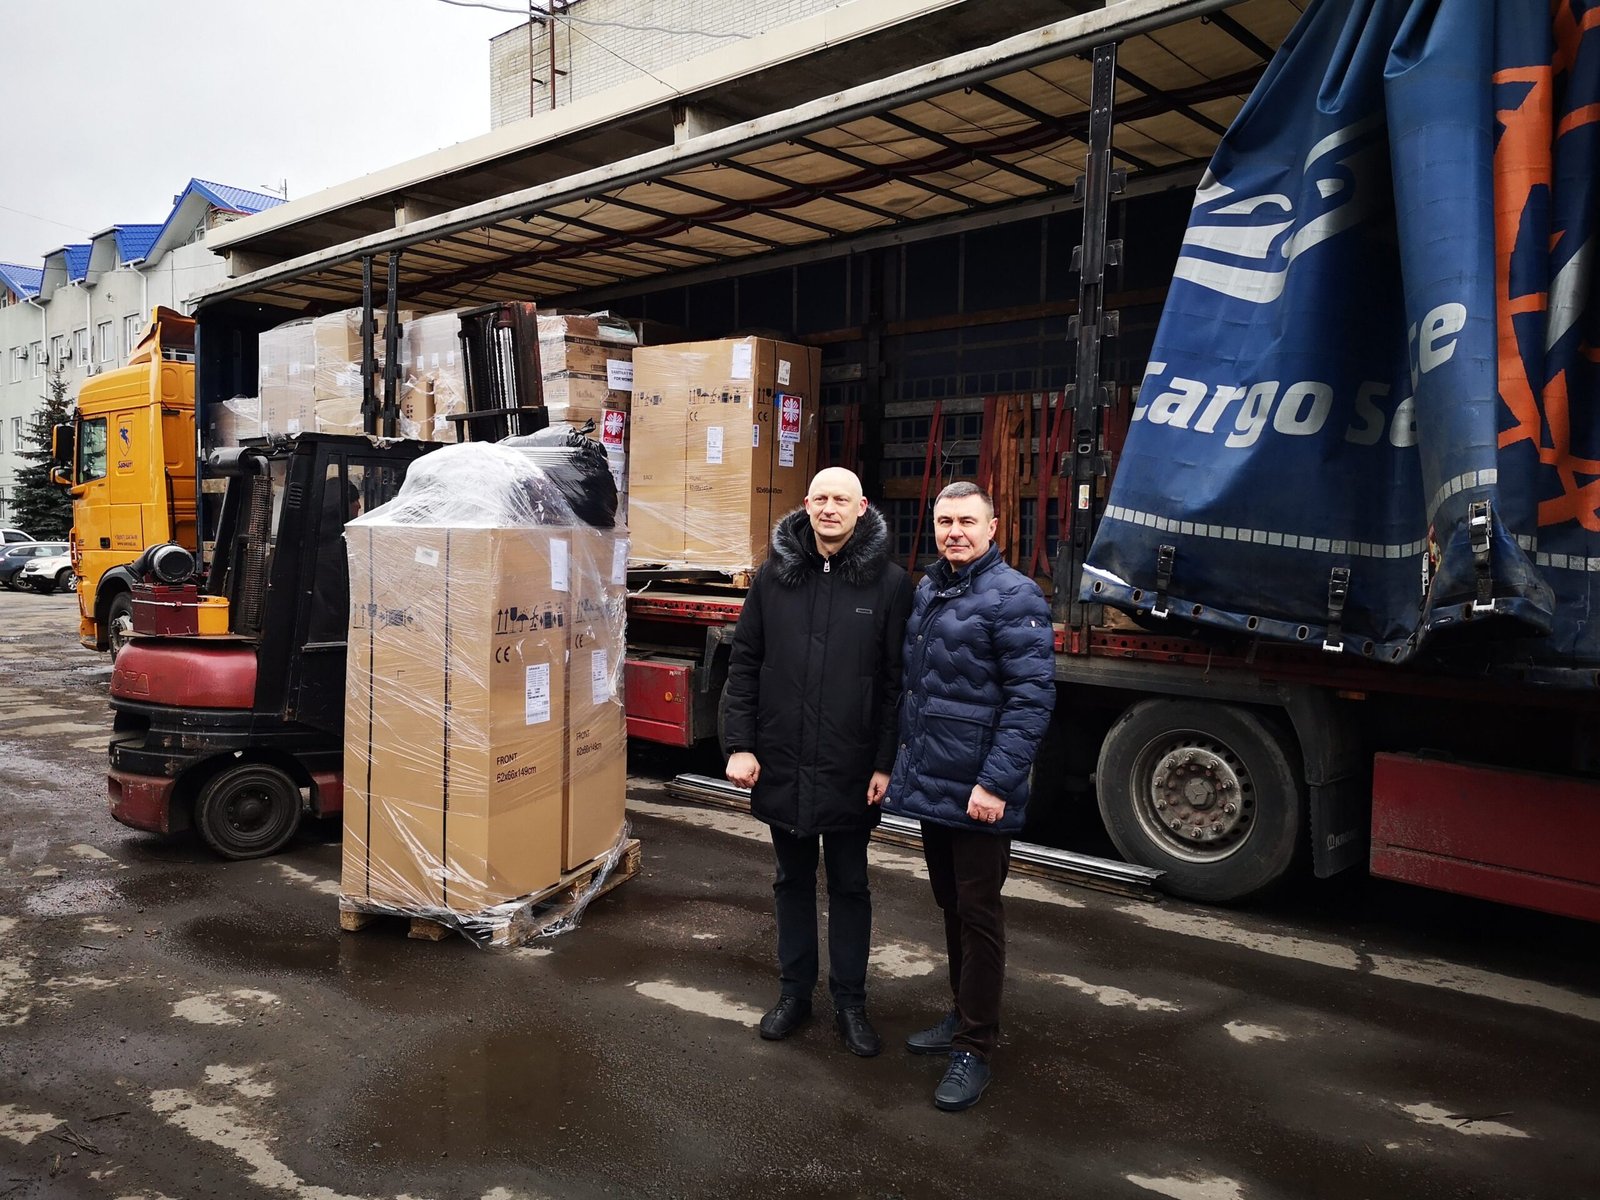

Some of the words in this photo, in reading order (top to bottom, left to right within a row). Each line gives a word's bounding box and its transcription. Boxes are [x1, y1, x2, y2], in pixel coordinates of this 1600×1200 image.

[1131, 361, 1334, 448] Cargo
[757, 411, 769, 422] CE
[575, 633, 584, 649] CE
[495, 646, 511, 663] CE
[576, 729, 591, 741] FRONT
[496, 752, 519, 766] FRONT
[496, 766, 537, 783] 62x66x149cm
